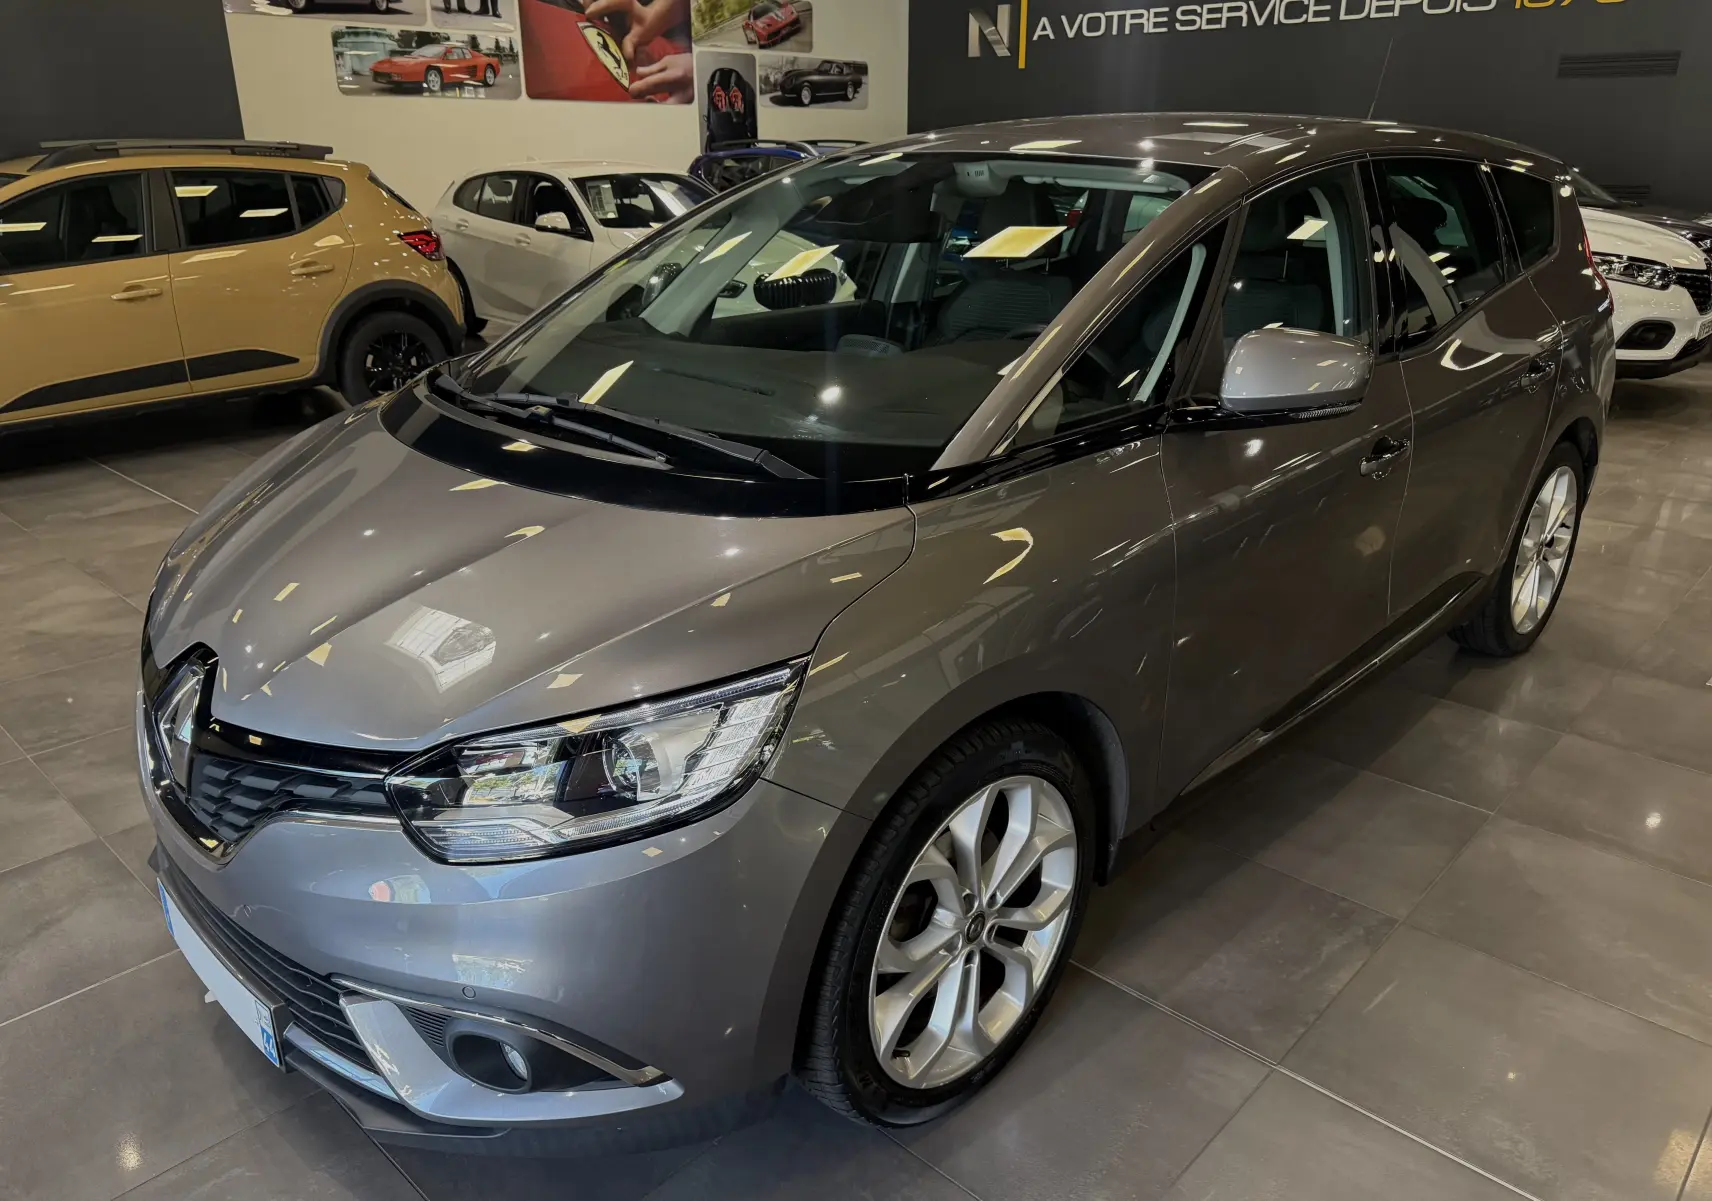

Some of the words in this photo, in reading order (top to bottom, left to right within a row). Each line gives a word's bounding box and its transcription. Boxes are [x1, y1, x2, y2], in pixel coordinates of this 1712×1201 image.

[1032, 16, 1055, 41] A
[1061, 7, 1169, 38] VOTRE
[1175, 0, 1331, 31] SERVICE
[263, 1031, 276, 1058] 44
